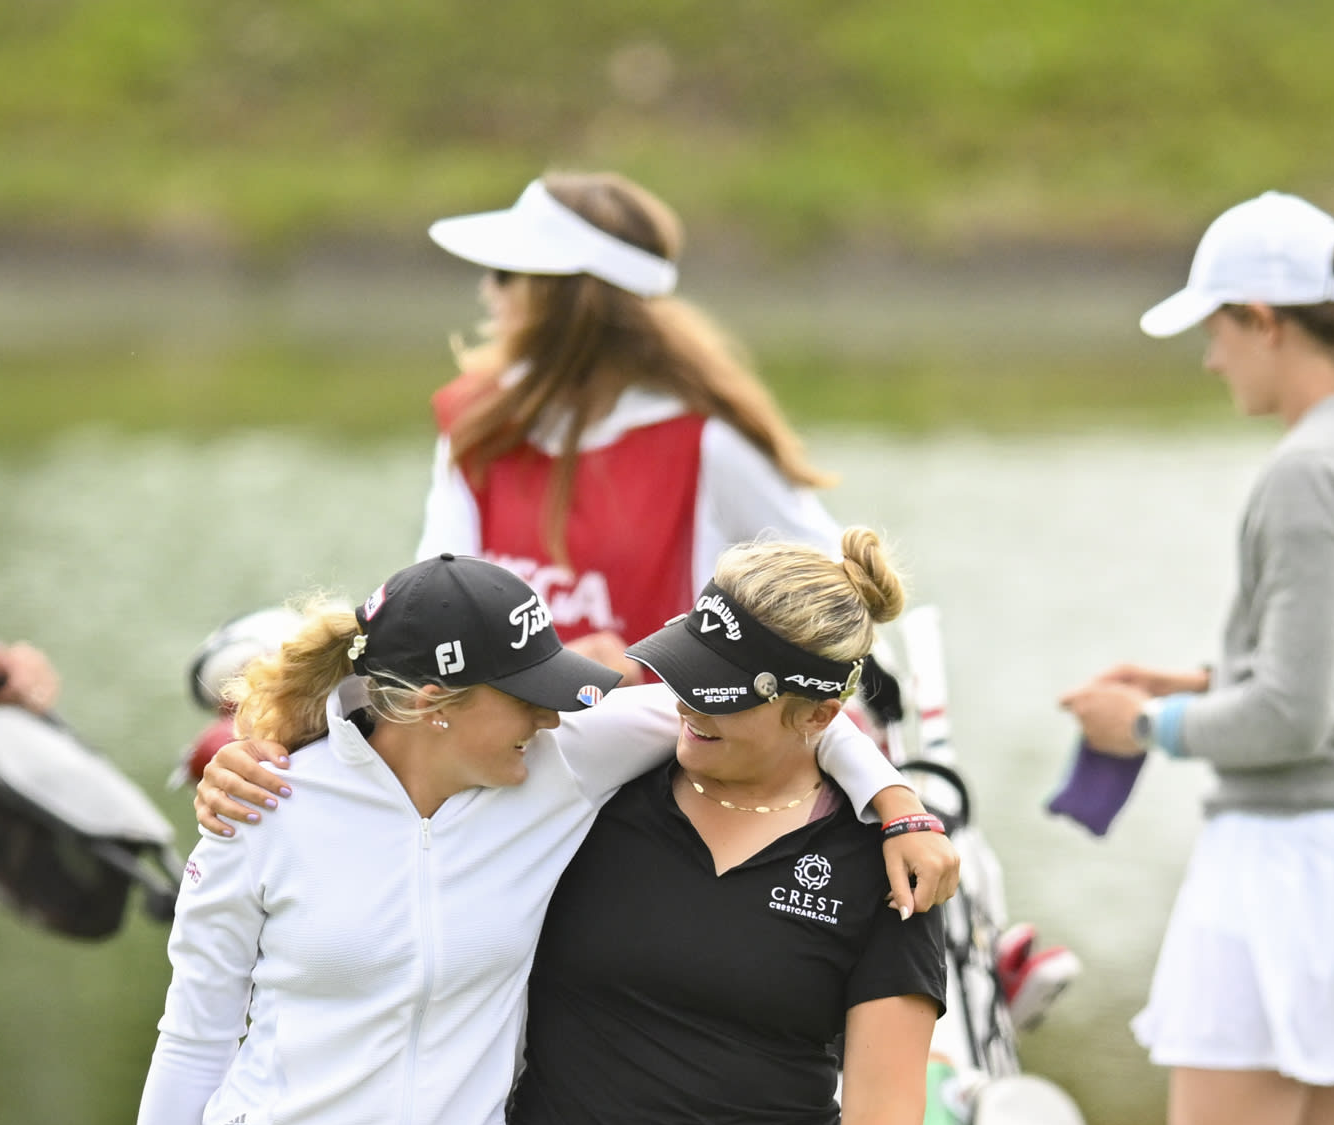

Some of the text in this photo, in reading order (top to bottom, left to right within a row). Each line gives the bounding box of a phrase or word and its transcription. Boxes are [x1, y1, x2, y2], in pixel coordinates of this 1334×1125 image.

[695, 594, 742, 641] Callaway
[435, 639, 465, 676] FJ
[692, 686, 748, 696] CHROME
[784, 674, 845, 692] APEX
[704, 695, 738, 703] SOFT
[771, 886, 843, 915] CREST
[769, 901, 838, 924] CRESTCARS.COM
